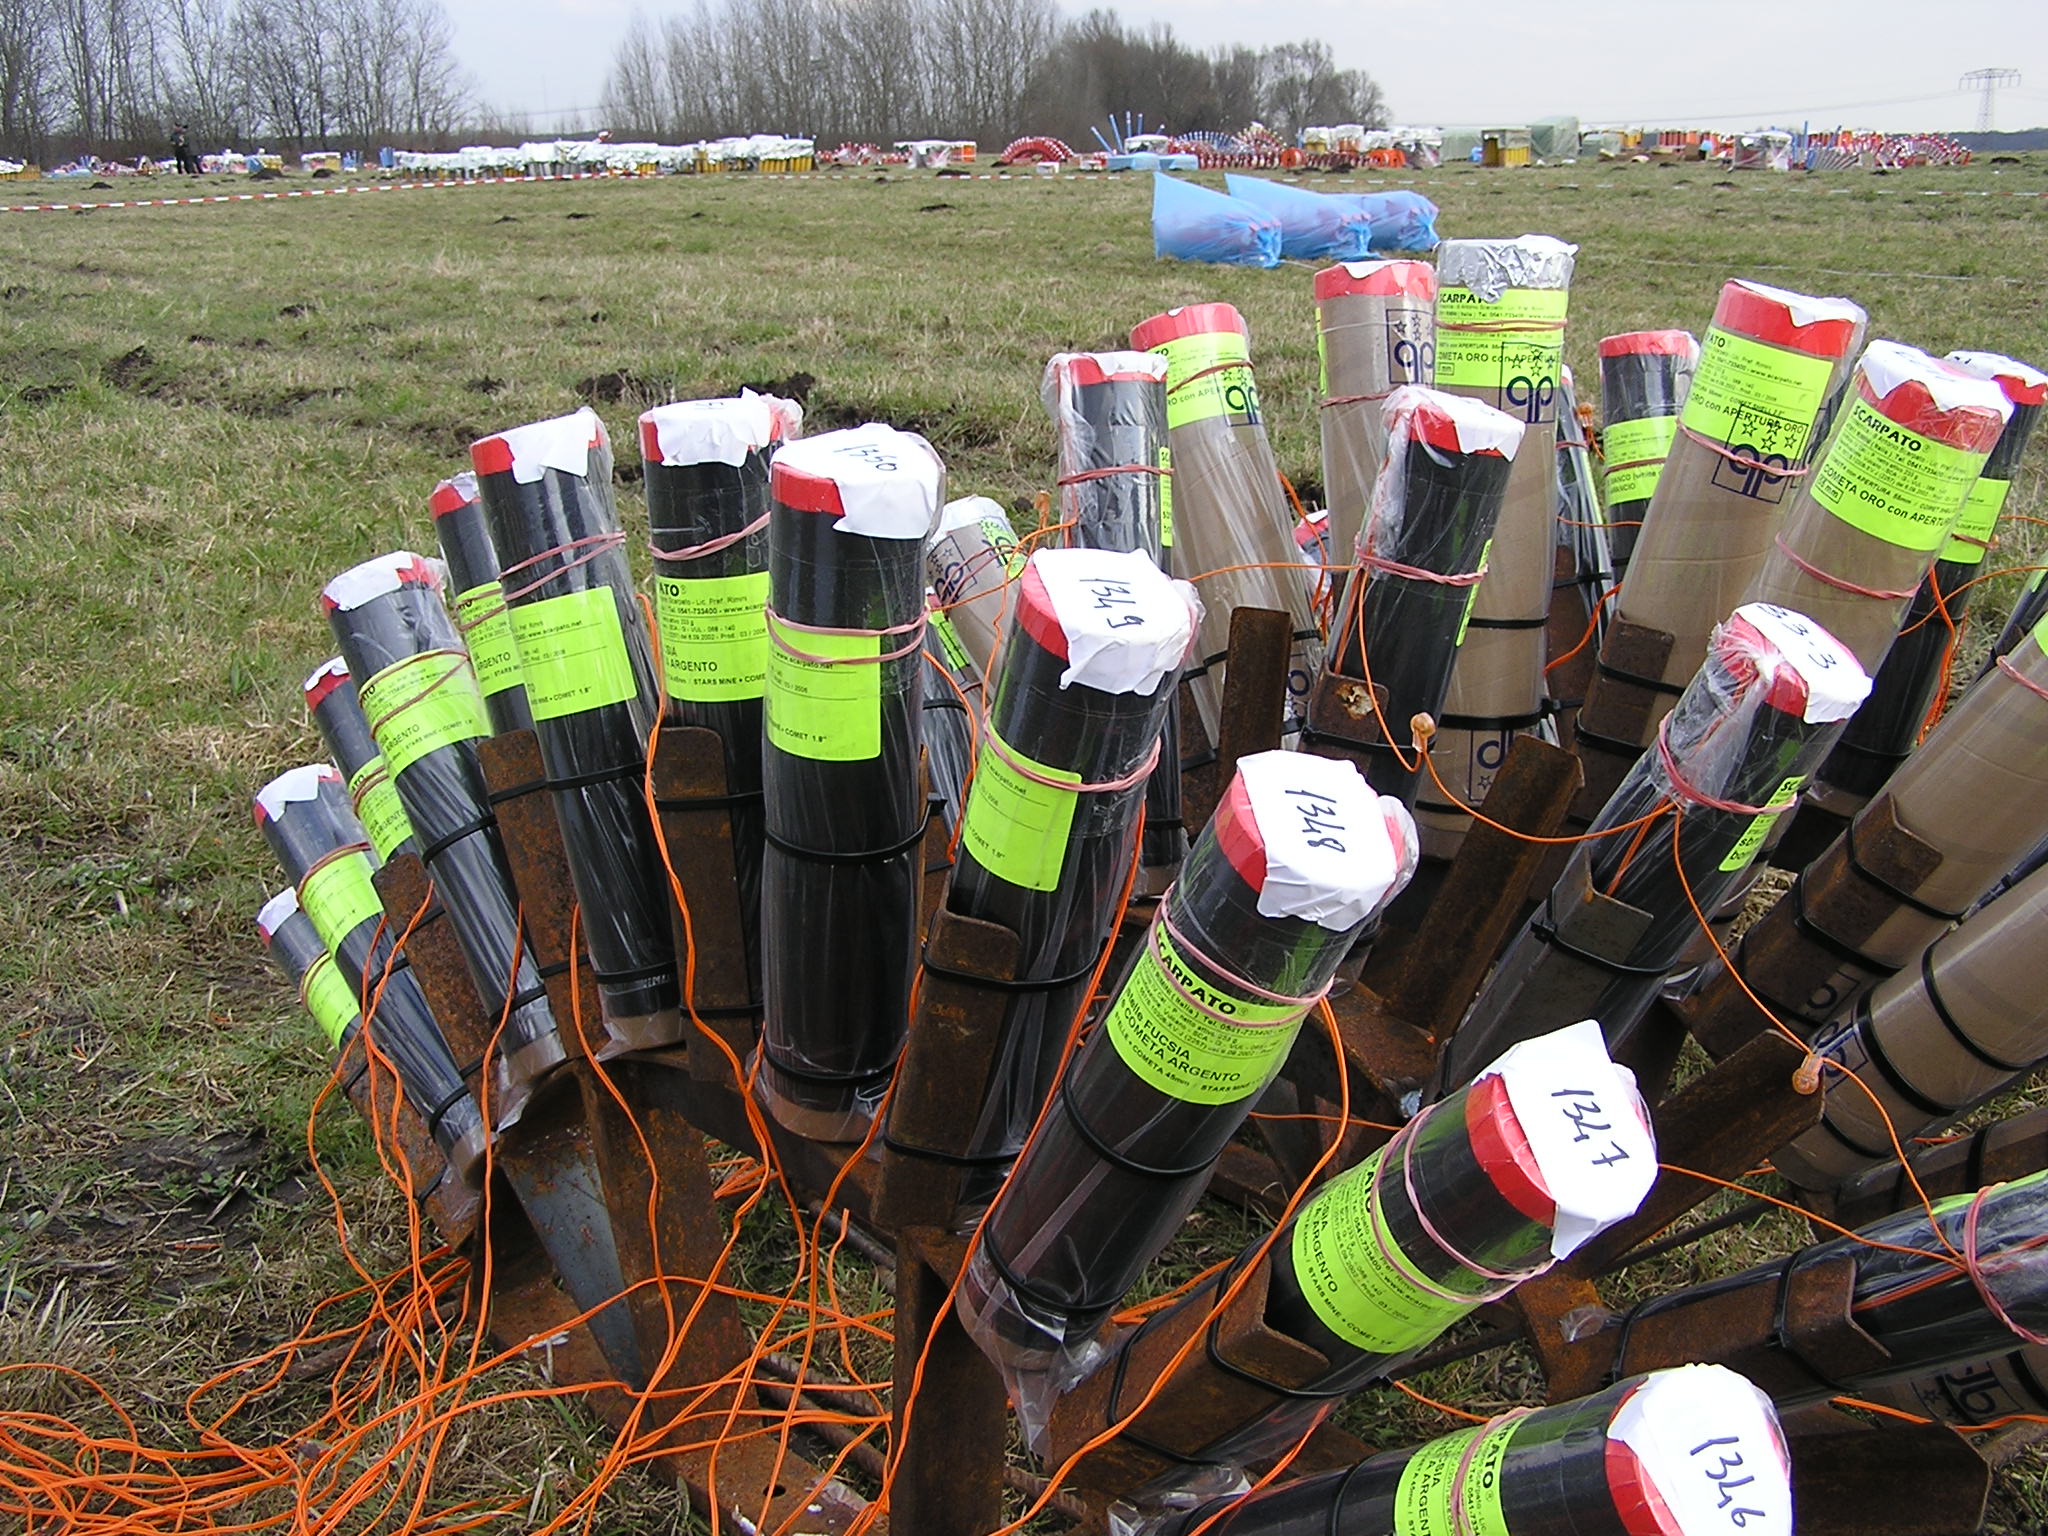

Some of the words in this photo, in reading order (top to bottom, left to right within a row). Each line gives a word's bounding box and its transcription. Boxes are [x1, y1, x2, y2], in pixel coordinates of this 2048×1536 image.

[1466, 352, 1489, 361] ORO
[1491, 354, 1508, 362] con
[1180, 394, 1195, 402] con
[1705, 402, 1721, 412] con
[1783, 423, 1804, 434] ORO
[1852, 405, 1921, 451] SCARPATO
[1860, 490, 1885, 508] ORO
[1888, 505, 1908, 518] con
[659, 583, 679, 596] ATO
[1079, 578, 1144, 628] 1349
[528, 620, 582, 638] www.scarpato.net
[670, 660, 718, 672] ARGENTO
[775, 651, 834, 669] www.scarpato.net
[1285, 789, 1345, 852] 1348
[1124, 1009, 1164, 1060] COMETA
[1167, 1058, 1241, 1082] ARGENTO
[1132, 1044, 1164, 1074] COMETA
[1145, 1020, 1190, 1060] FUCSIA
[1551, 1089, 1629, 1167] 1347
[1313, 1220, 1338, 1293] ARGENTO
[1308, 1266, 1324, 1297] STARS
[1324, 1298, 1342, 1319] MINE
[1347, 1322, 1377, 1342] COMET
[1690, 1436, 1765, 1527] 1346
[1418, 1473, 1432, 1536] ARGENT
